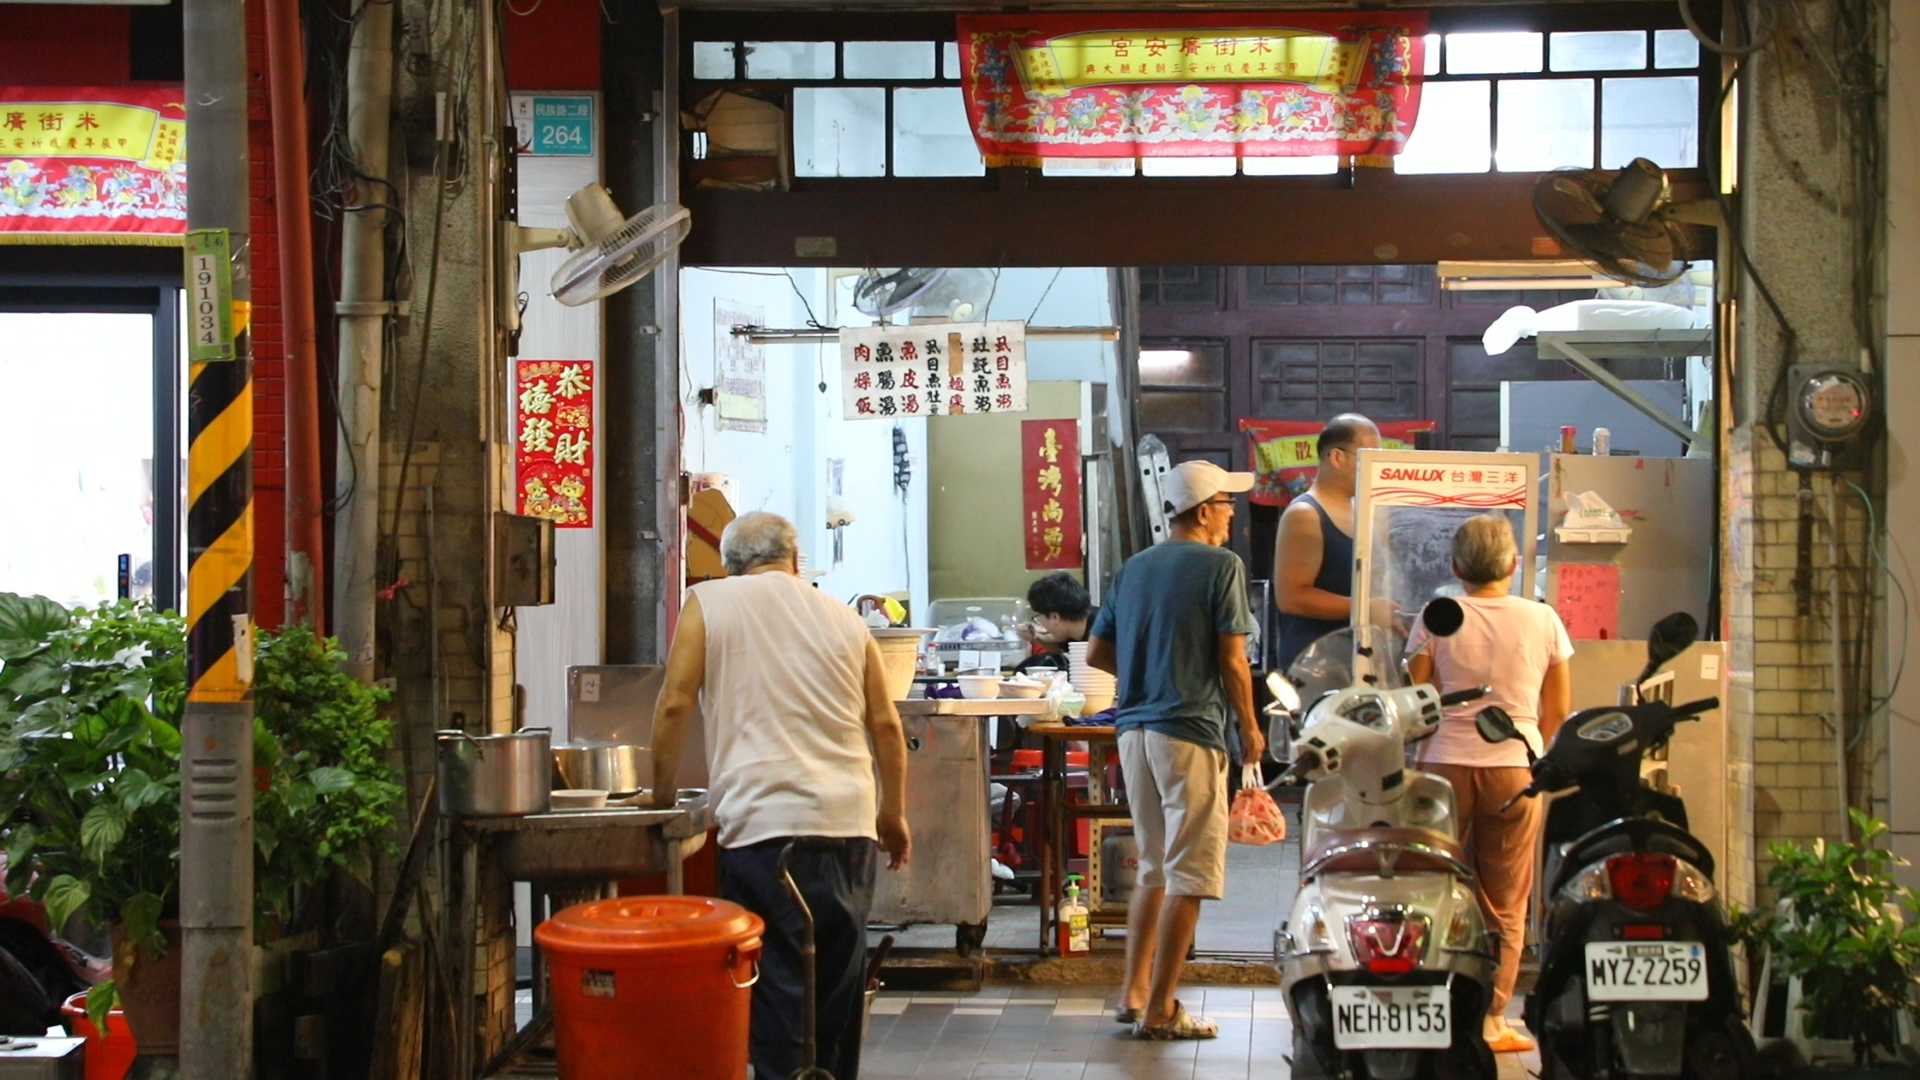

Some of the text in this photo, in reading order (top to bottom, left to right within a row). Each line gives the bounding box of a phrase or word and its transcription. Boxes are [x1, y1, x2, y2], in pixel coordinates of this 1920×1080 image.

[535, 104, 588, 117] 民族路二段
[542, 125, 582, 145] 264
[198, 257, 216, 344] 191034
[875, 341, 898, 416] 魚腸湯
[900, 341, 919, 413] 魚皮湯
[994, 336, 1012, 410] 虱目魚粥
[1380, 468, 1518, 484] SANLUX 台灣三洋
